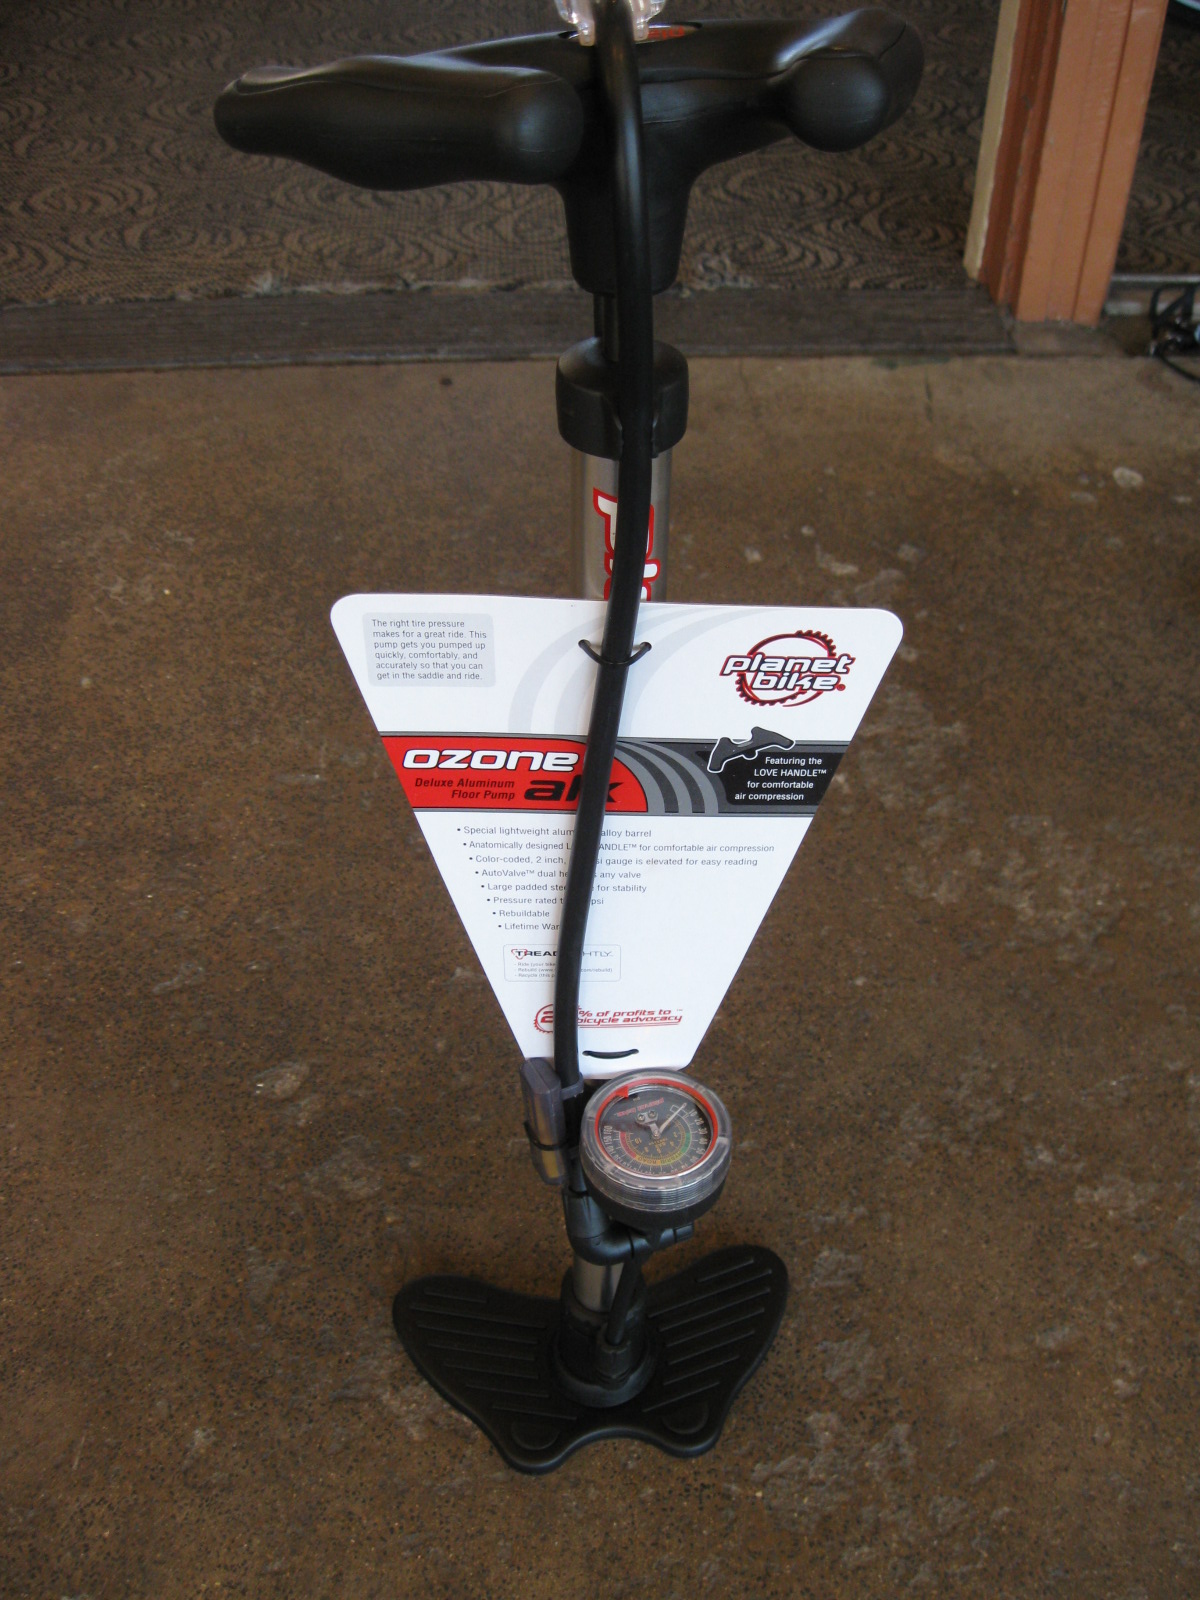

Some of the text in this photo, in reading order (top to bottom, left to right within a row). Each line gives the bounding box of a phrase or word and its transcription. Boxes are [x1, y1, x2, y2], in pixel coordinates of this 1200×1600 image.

[372, 619, 465, 630] The right tire pressure
[373, 630, 400, 639] makes
[402, 630, 415, 639] for
[424, 631, 446, 641] great
[448, 631, 467, 639] ride.
[469, 631, 487, 640] This
[374, 641, 486, 651] pump gets you pumped up
[375, 651, 478, 661] quickly, comfortably, and
[376, 661, 418, 671] accurately
[432, 661, 449, 670] that
[451, 663, 466, 672] you
[720, 652, 856, 676] planet
[377, 671, 483, 681] get in the saddle and ride.
[752, 671, 842, 692] bike
[402, 748, 580, 772] ozone
[765, 756, 823, 767] Featuring the
[754, 768, 778, 777] LOVE
[415, 778, 515, 788] Deluxe Aluminum
[747, 780, 814, 789] for comfortable
[451, 789, 515, 801] Floor Pump
[734, 792, 805, 802] air compression
[463, 826, 497, 836] Special
[499, 826, 550, 837] lightweight
[600, 829, 622, 838] alloy
[625, 829, 652, 838] barrel
[469, 841, 525, 851] Anatomically
[525, 841, 564, 851] designed
[639, 844, 651, 852] for
[653, 844, 704, 852] comfortable
[706, 844, 718, 852] air
[719, 844, 775, 854] compression
[475, 855, 533, 864] Color-coded,
[535, 856, 542, 864] 2
[544, 855, 567, 865] inch,
[605, 858, 633, 867] gauge
[635, 858, 644, 866] is
[645, 858, 683, 866] elevated
[685, 858, 699, 866] for
[701, 858, 722, 867] easy
[724, 858, 758, 867] reading
[537, 870, 556, 878] dual
[599, 872, 616, 880] any
[618, 871, 642, 879] valve
[487, 883, 513, 892] Large
[515, 883, 548, 892] padded
[597, 884, 610, 892] for
[612, 884, 647, 894] stability
[493, 896, 532, 905] Pressure
[535, 896, 557, 905] rated
[591, 897, 604, 906] psi
[499, 909, 550, 918] Rebuildable
[504, 922, 539, 931] Lifetime
[612, 1009, 655, 1019] profits
[622, 1015, 682, 1025] advocacy
